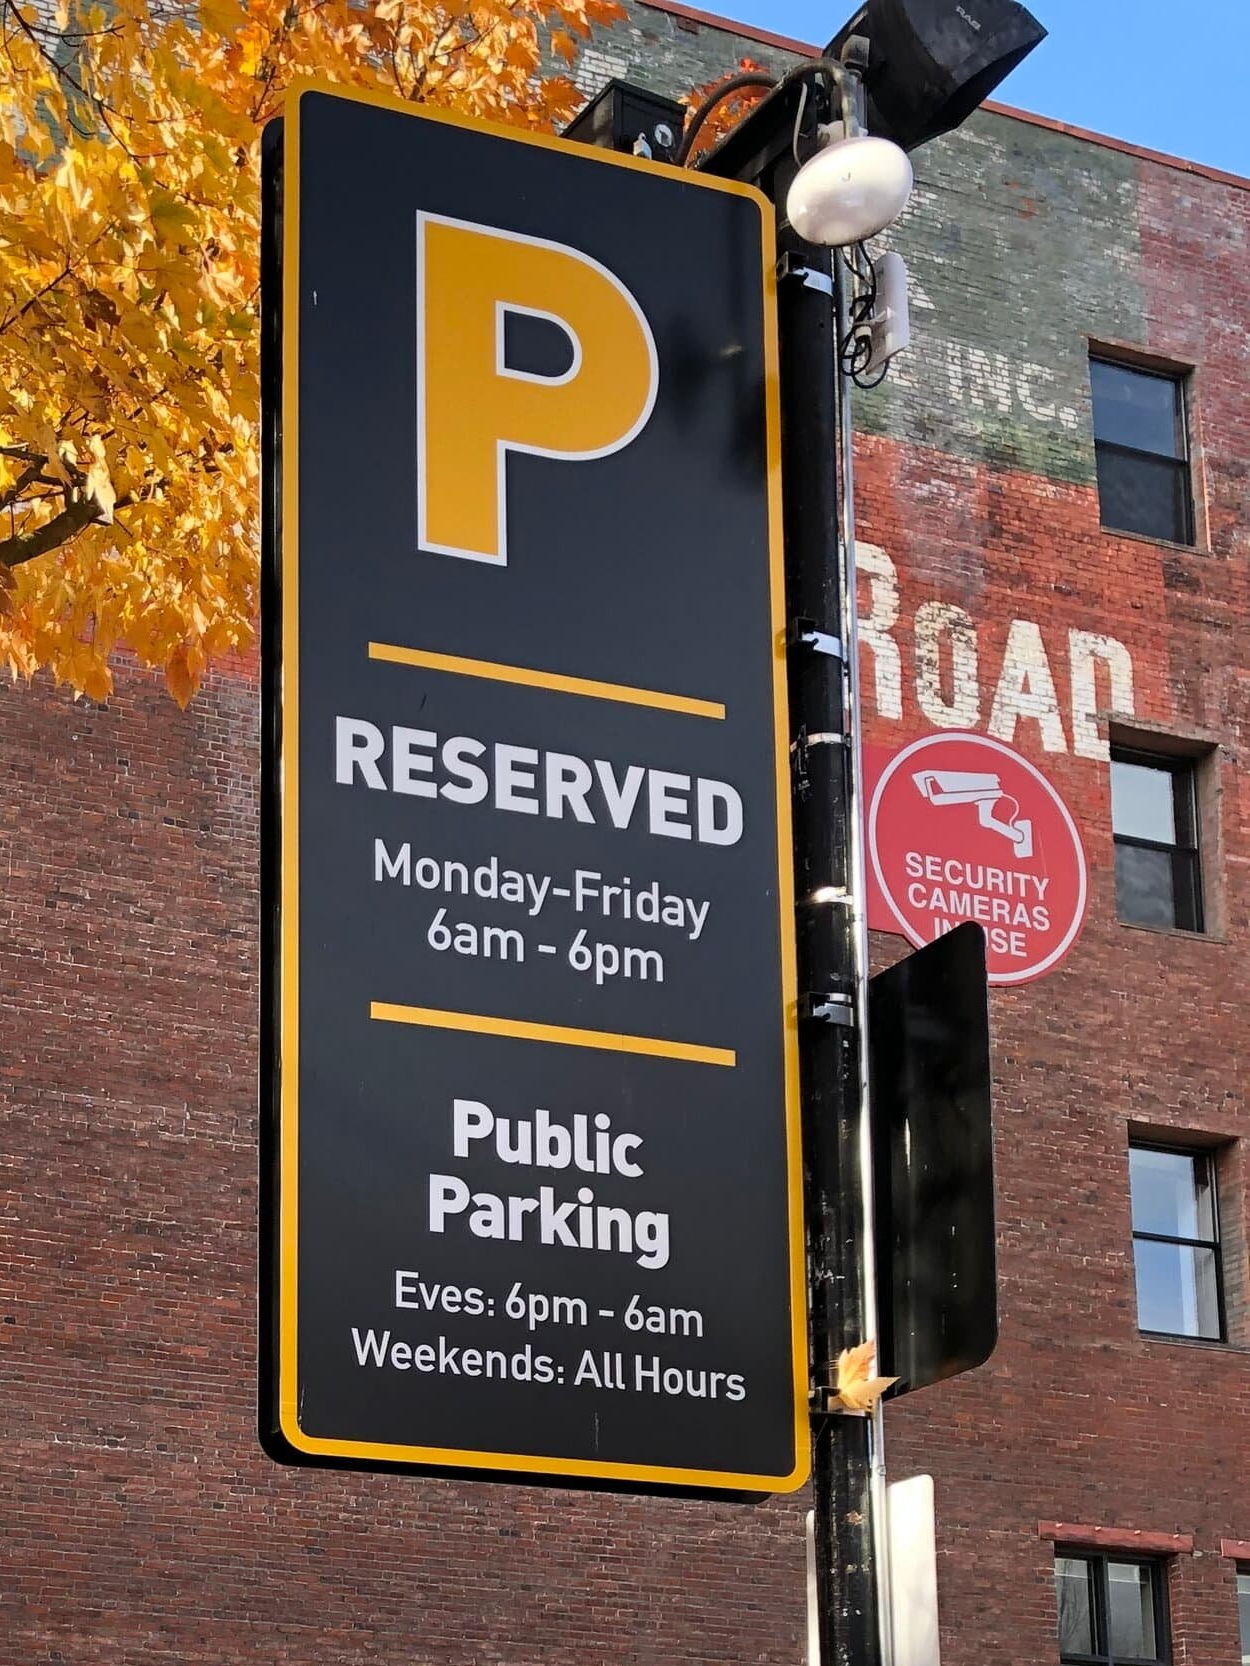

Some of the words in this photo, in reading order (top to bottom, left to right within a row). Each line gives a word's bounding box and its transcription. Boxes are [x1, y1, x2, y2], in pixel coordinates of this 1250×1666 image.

[417, 209, 659, 566] P
[335, 716, 744, 847] RESERVED
[374, 838, 711, 940] Monday-Friday
[905, 851, 1049, 901] SECURITY
[908, 883, 1050, 932] CAMERAS
[427, 908, 525, 962] 6am
[538, 944, 557, 954] -
[568, 929, 664, 985] 6pm
[984, 926, 1027, 957] SE
[453, 1098, 644, 1178] Public
[429, 1173, 670, 1270] Parking
[395, 1270, 495, 1317] Eves:
[505, 1282, 588, 1331] 6pm
[599, 1308, 615, 1318] -
[624, 1295, 703, 1338] 6am
[351, 1327, 565, 1385] Weekends:
[574, 1350, 626, 1390] All
[635, 1355, 747, 1401] Hours
